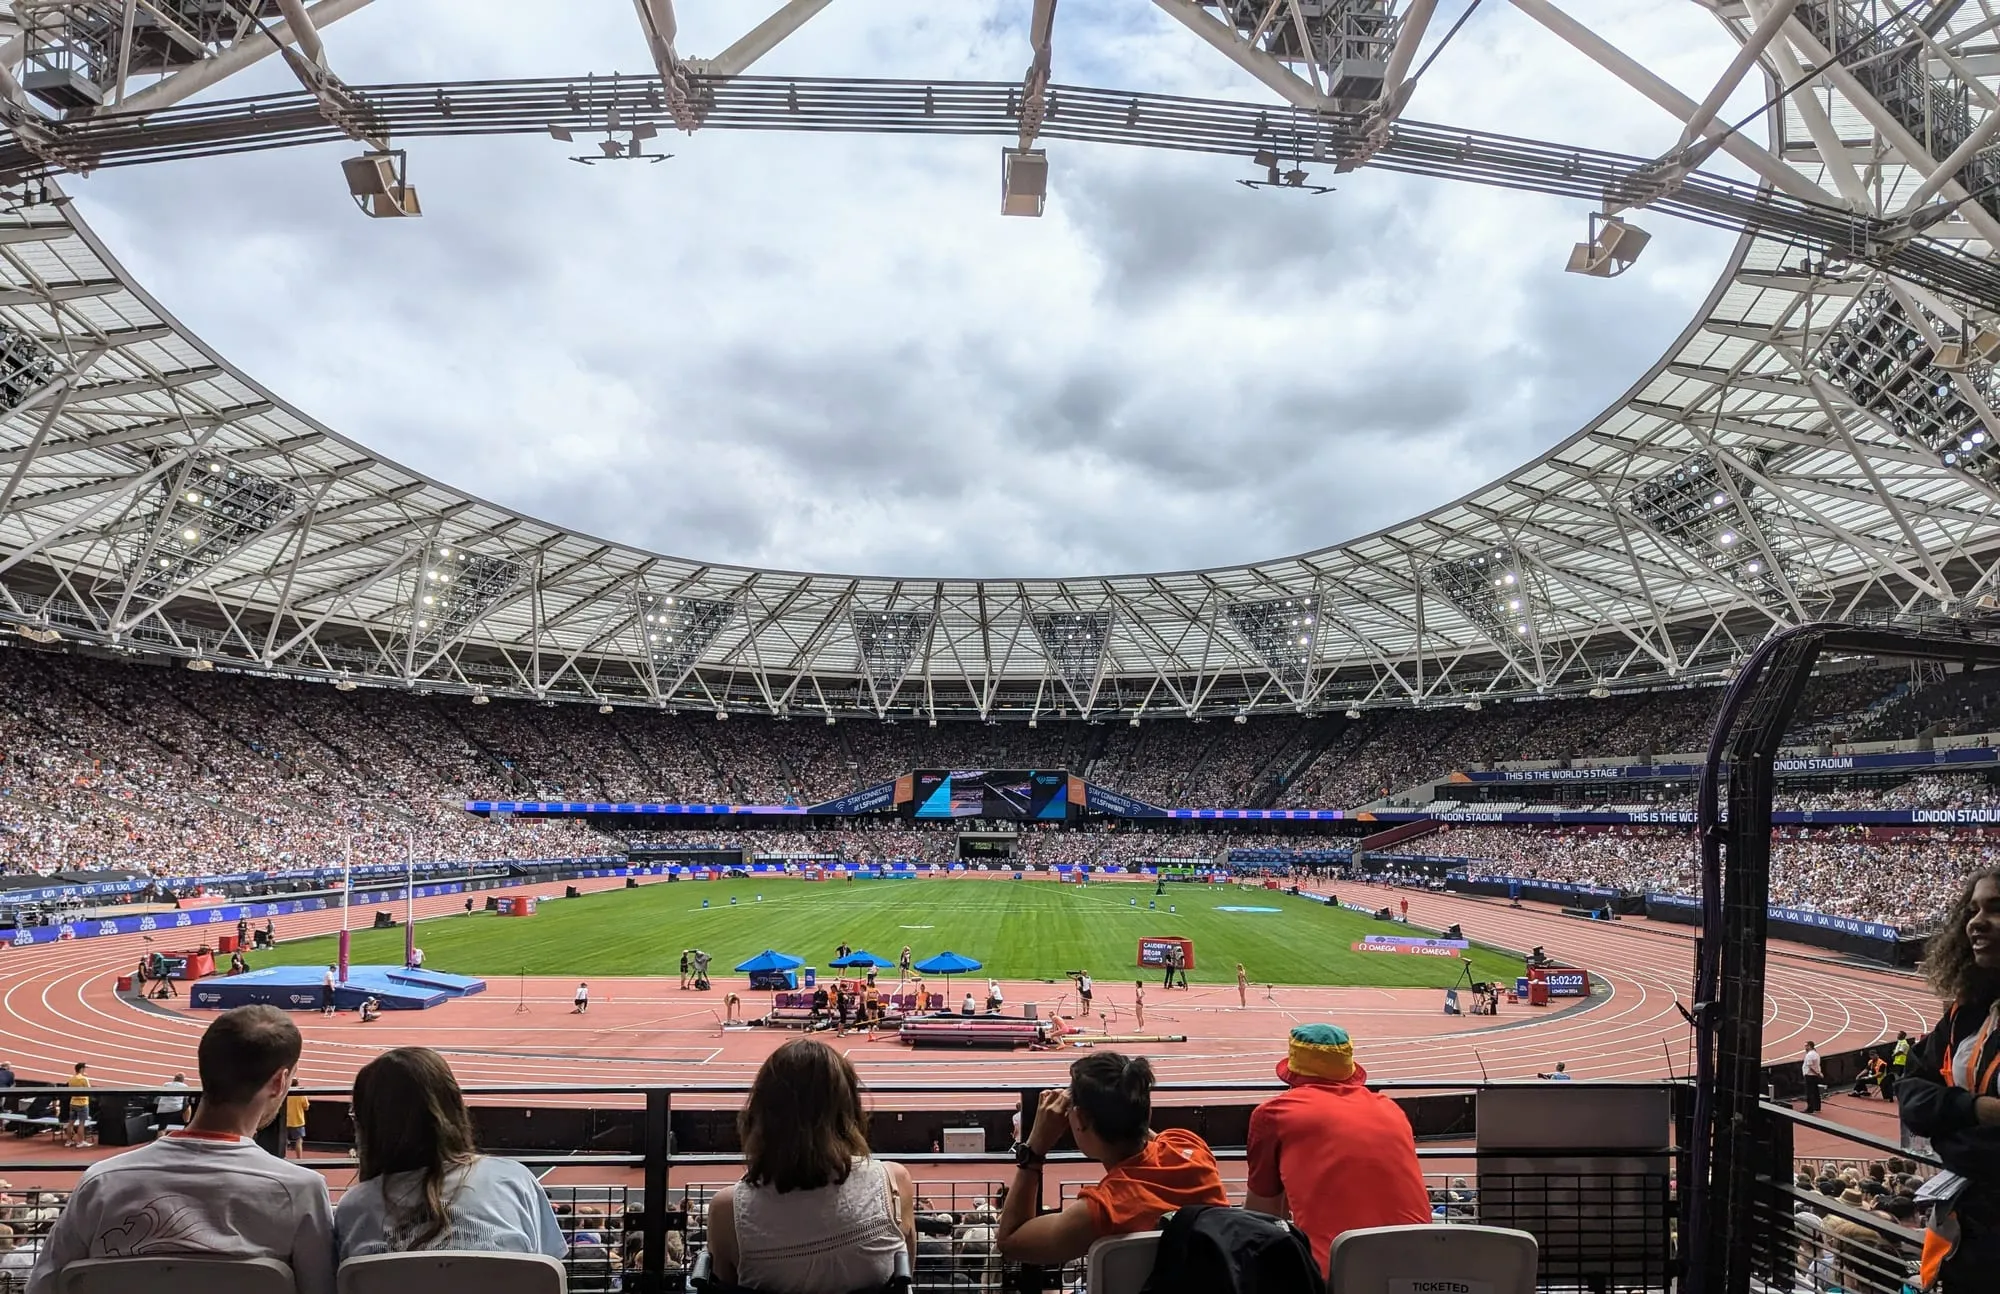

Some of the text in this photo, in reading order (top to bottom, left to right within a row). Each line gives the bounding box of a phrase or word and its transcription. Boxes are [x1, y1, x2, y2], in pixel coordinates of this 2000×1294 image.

[1772, 758, 1853, 771] ONDON STADIUM
[1504, 768, 1618, 780] THIS IS THE WORLD'S STAGE
[847, 785, 892, 806] STAY CONNECTED
[1088, 787, 1131, 808] STAY CONNECTED
[1465, 813, 1502, 822] STADIUM
[1628, 812, 1648, 822] THIS
[1650, 812, 1658, 822] IS
[1660, 812, 1678, 822] THE
[1912, 810, 1956, 822] LONDON
[1368, 944, 1396, 952] OMEGA
[1421, 948, 1451, 956] OMEGA
[1546, 976, 1582, 984] 15:02:22
[1412, 1282, 1469, 1294] TICKETED
